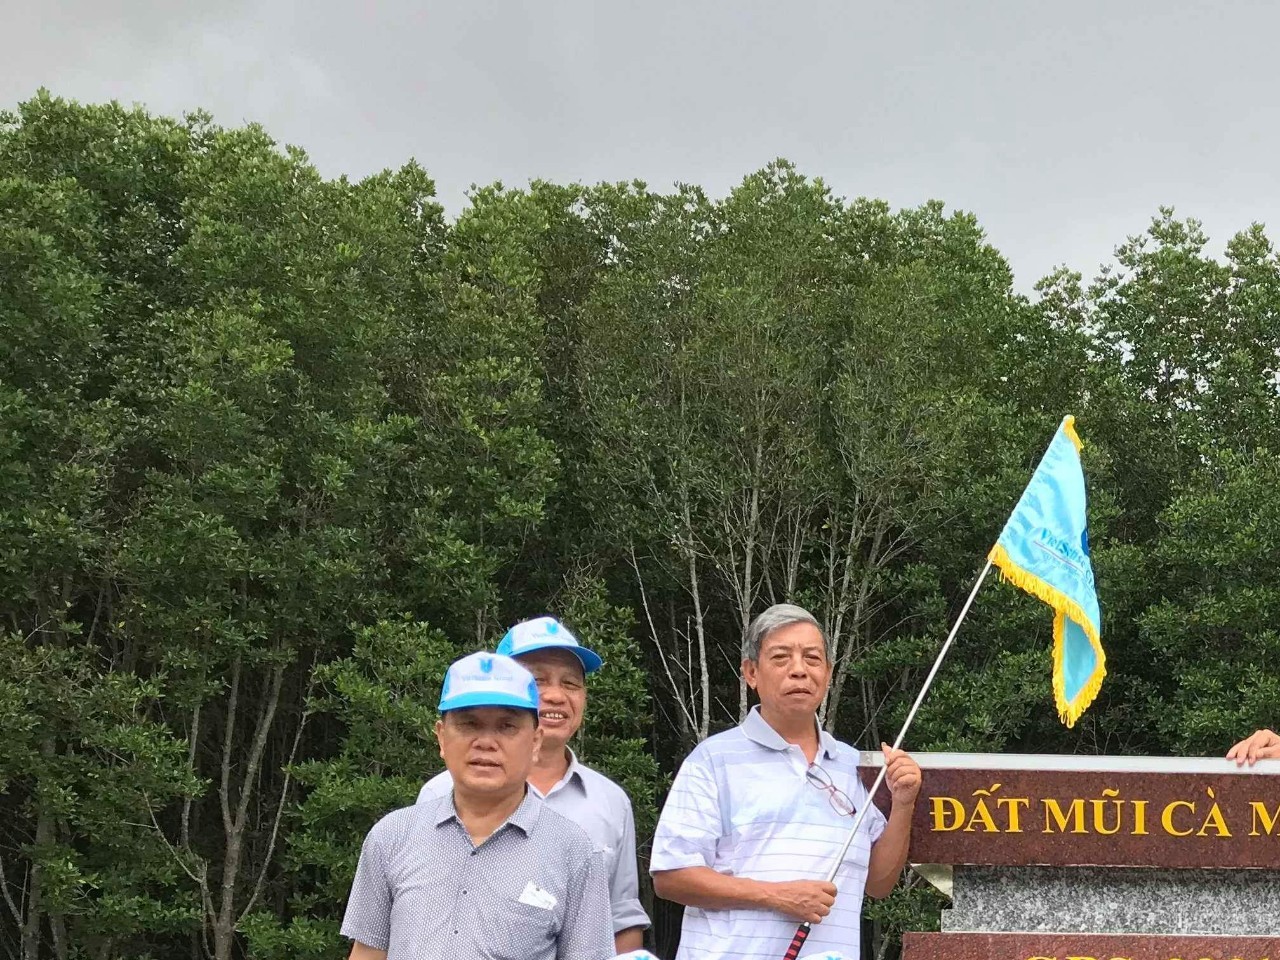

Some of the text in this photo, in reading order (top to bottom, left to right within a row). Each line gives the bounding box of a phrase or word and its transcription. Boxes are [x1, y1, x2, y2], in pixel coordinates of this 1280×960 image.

[929, 783, 1029, 834] ĐẤT
[1042, 788, 1149, 836] MŨI
[1161, 786, 1232, 838] CÀ
